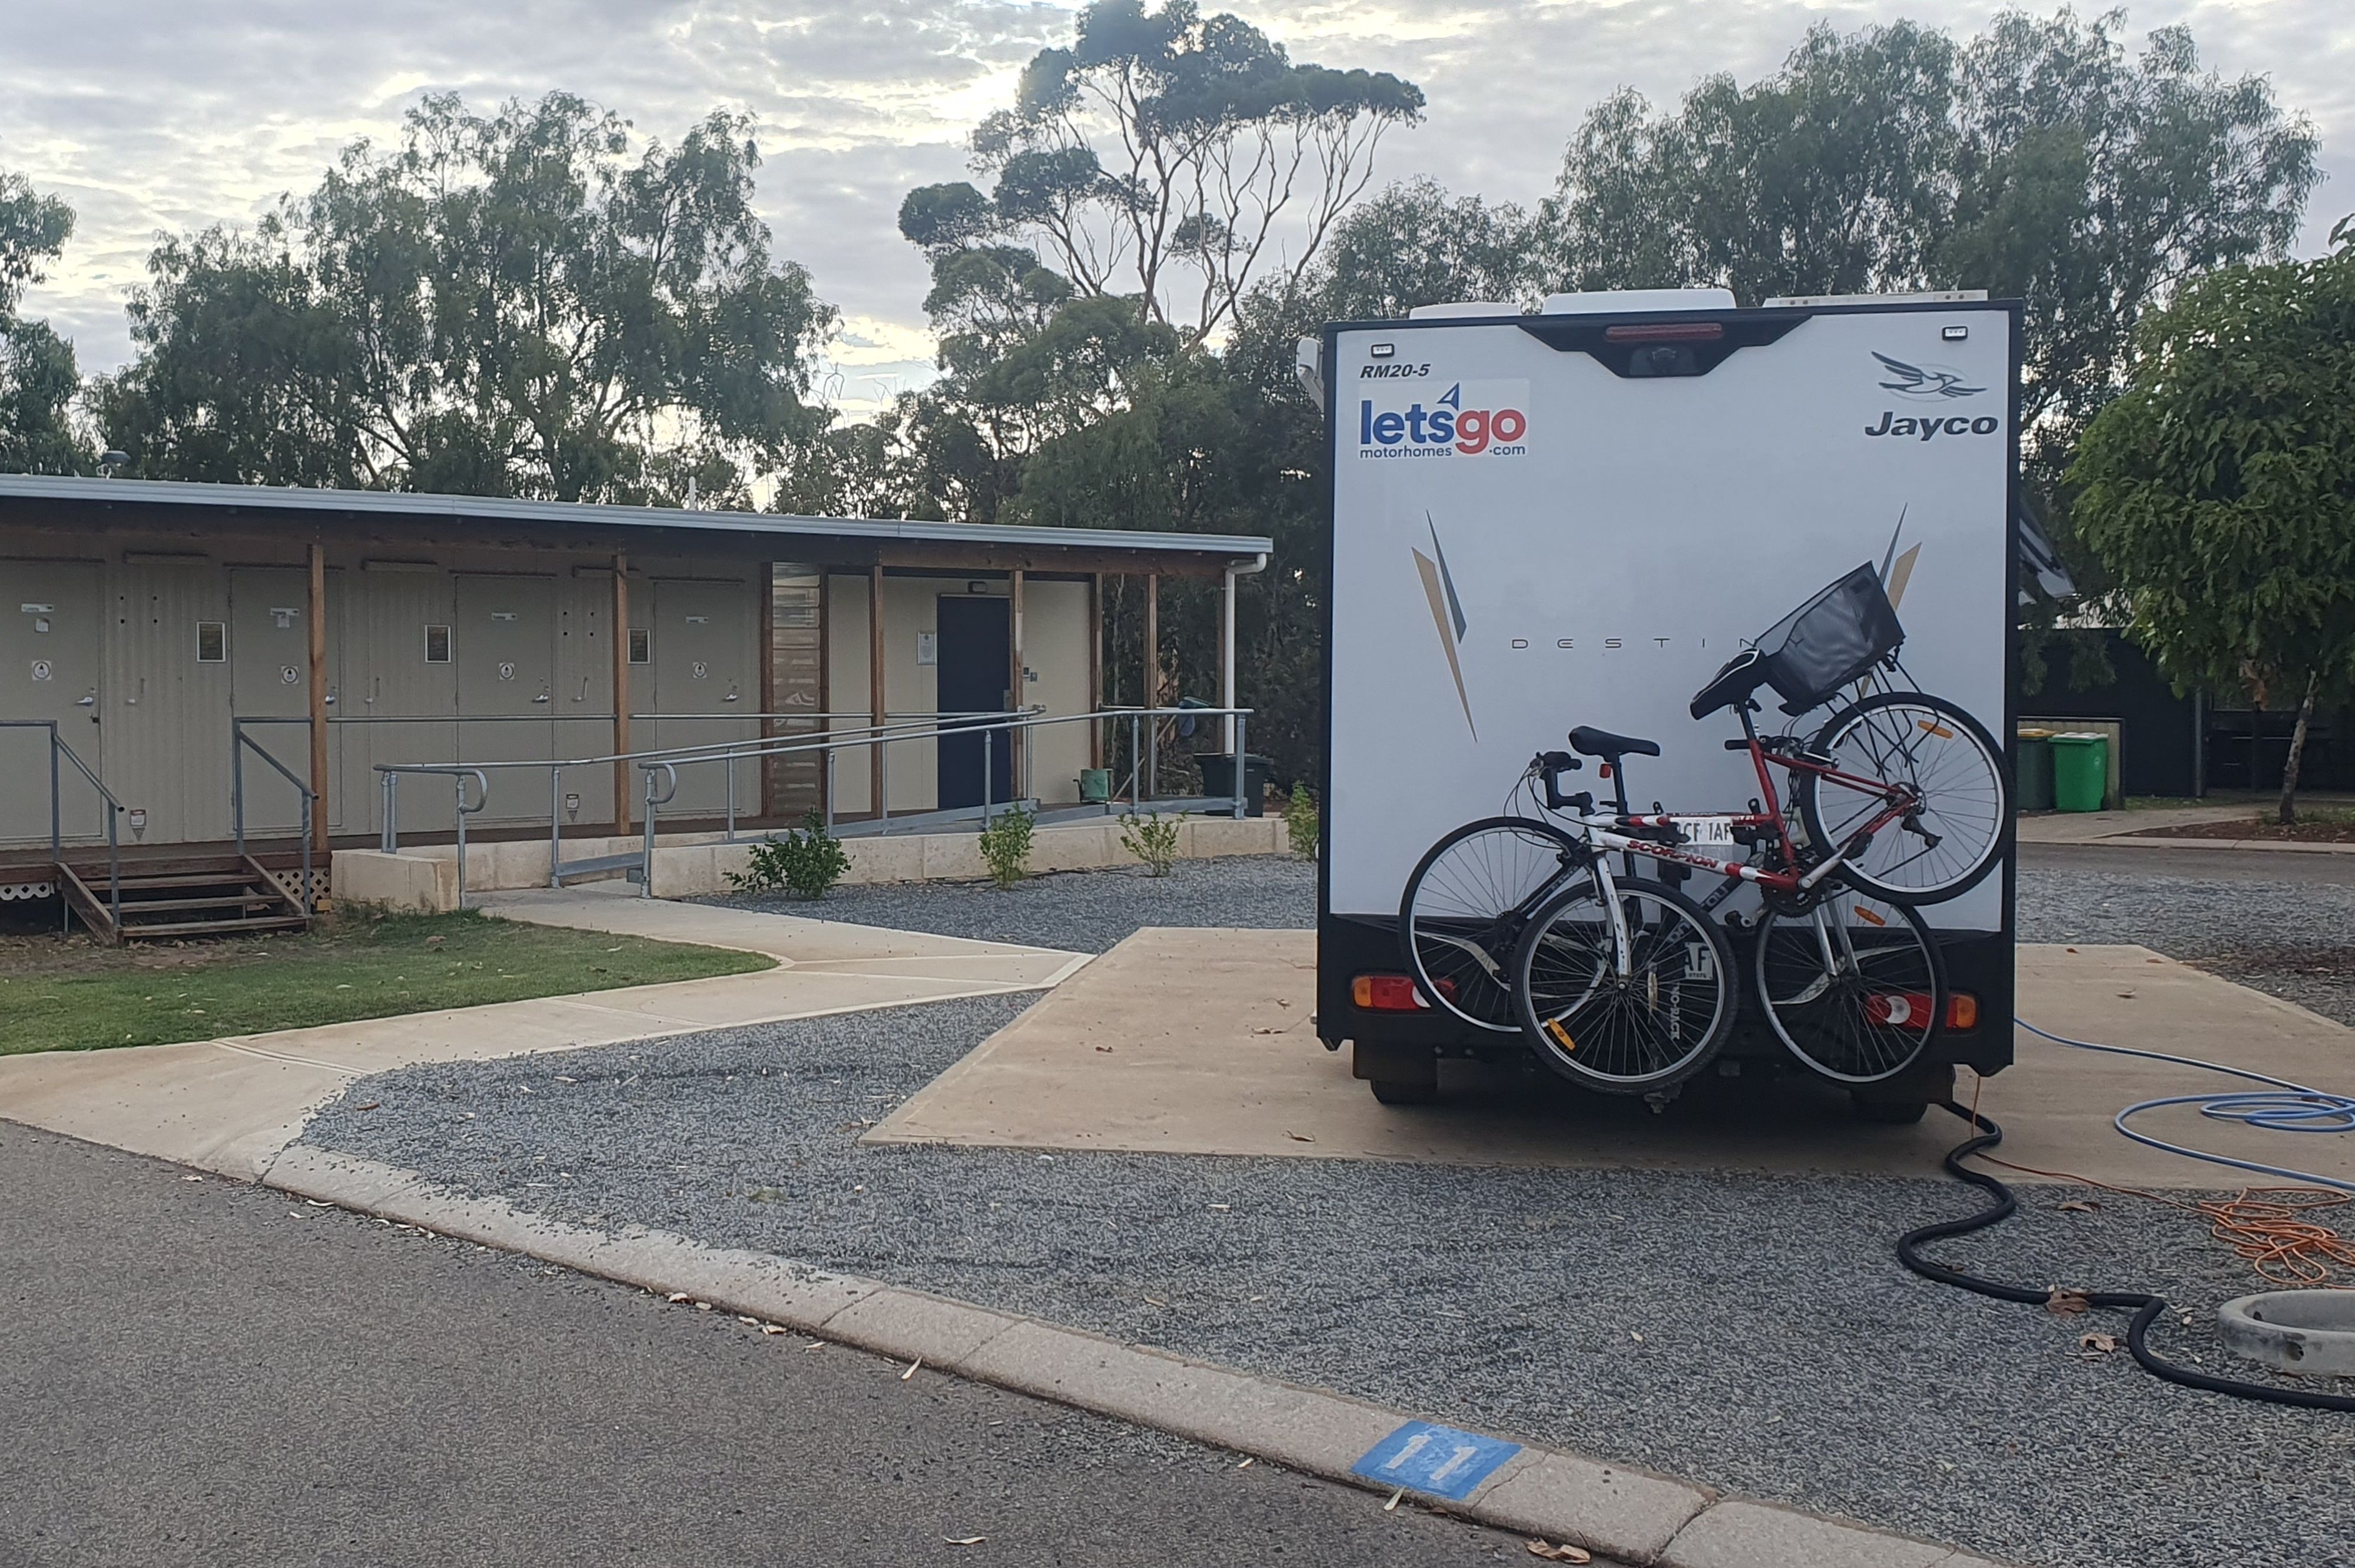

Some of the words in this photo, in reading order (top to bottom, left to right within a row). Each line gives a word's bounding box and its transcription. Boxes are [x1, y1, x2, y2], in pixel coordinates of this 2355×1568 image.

[1360, 363, 1431, 378] RM20-5
[1865, 411, 1998, 441] Jayco
[1360, 445, 1452, 459] motorhomes
[1489, 446, 1525, 456] .com
[1627, 839, 1719, 868] SCORPION
[1385, 1434, 1478, 1481] 11
